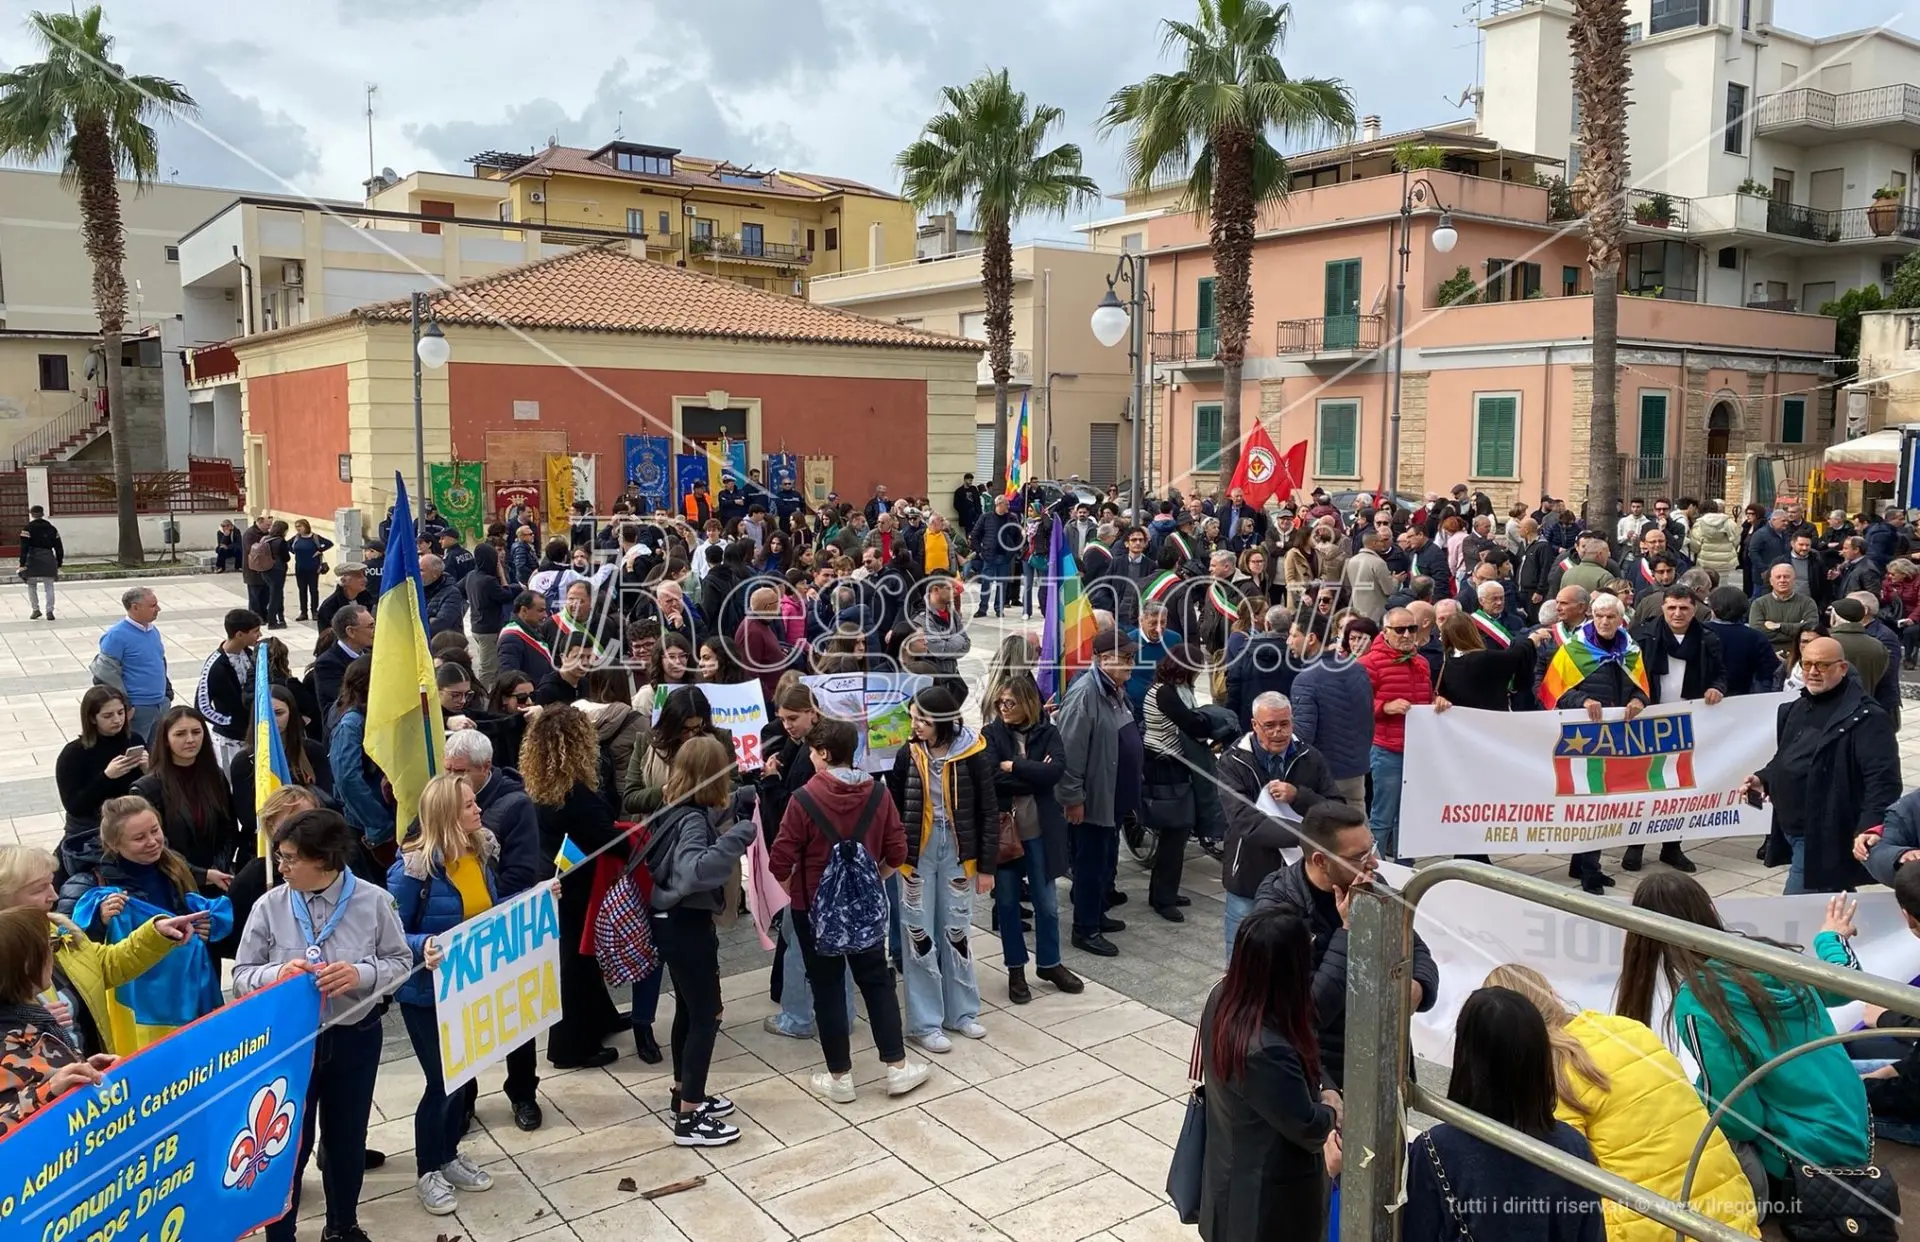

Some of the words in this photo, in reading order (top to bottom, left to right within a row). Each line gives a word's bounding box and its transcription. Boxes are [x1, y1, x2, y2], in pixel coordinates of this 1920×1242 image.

[1591, 716, 1693, 756] A.N.P.I.
[1441, 803, 1554, 824] ASSOCIAZIONE
[1564, 801, 1644, 822] NAZIONALE
[1651, 797, 1722, 816] PARTIGIANI
[1485, 827, 1519, 843] AREA
[1527, 823, 1622, 842] METROPOLITANA
[1628, 820, 1641, 836] DI
[1647, 818, 1684, 834] REGGIO
[1689, 810, 1740, 828] CALABRIA
[441, 959, 560, 1080] LIBERA
[21, 1141, 79, 1205] Adulti
[84, 1108, 136, 1155] Scout
[141, 1057, 214, 1118] Cattolici
[218, 1026, 271, 1073] Italiani
[67, 1077, 129, 1136] MASCI
[42, 1154, 148, 1242] Comunità
[153, 1133, 179, 1172] FB
[136, 1159, 196, 1219] Diana
